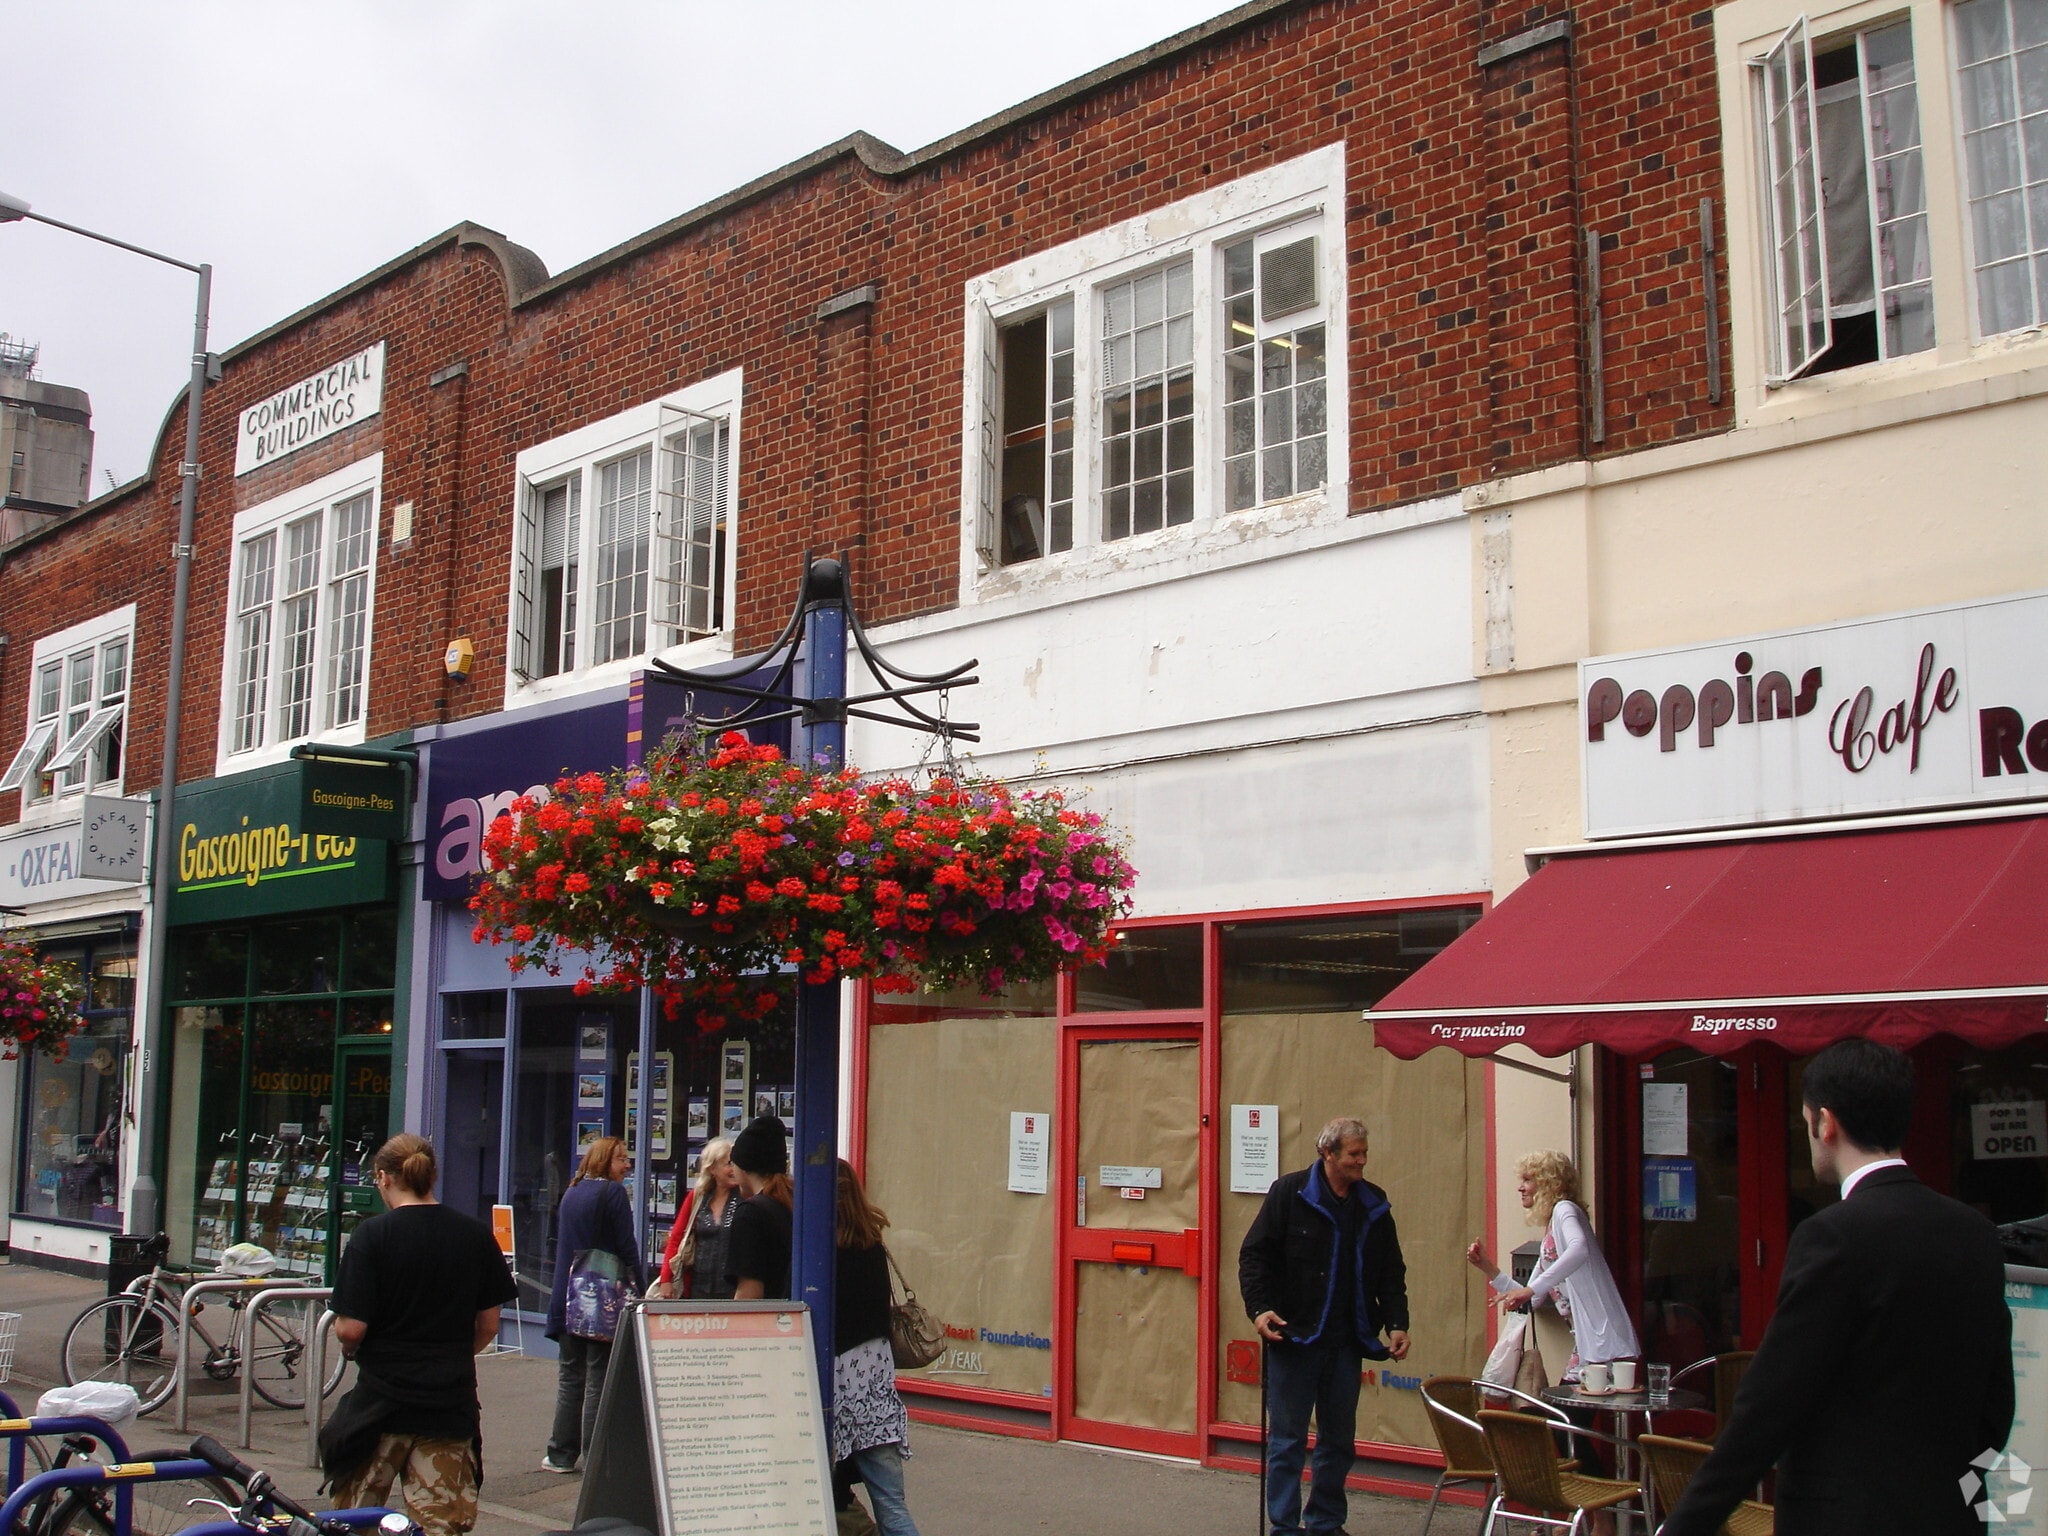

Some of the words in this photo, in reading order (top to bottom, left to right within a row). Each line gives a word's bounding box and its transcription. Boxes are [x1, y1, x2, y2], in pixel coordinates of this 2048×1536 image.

[246, 354, 370, 435] COMMERCIAL
[256, 393, 355, 460] BUILDINGS
[1588, 650, 1823, 753] Poppins
[1828, 641, 1960, 774] Cafe
[312, 788, 394, 810] Gascoigne-Pees
[90, 811, 138, 834] OXFAM
[20, 838, 81, 888] OXFA
[89, 844, 138, 866] OXFAM
[1690, 1014, 1778, 1035] Espresso
[1652, 1206, 1687, 1219] MILK
[660, 1313, 729, 1336] Poppins
[980, 1327, 1051, 1350] Foundation
[950, 1349, 982, 1372] YEARS
